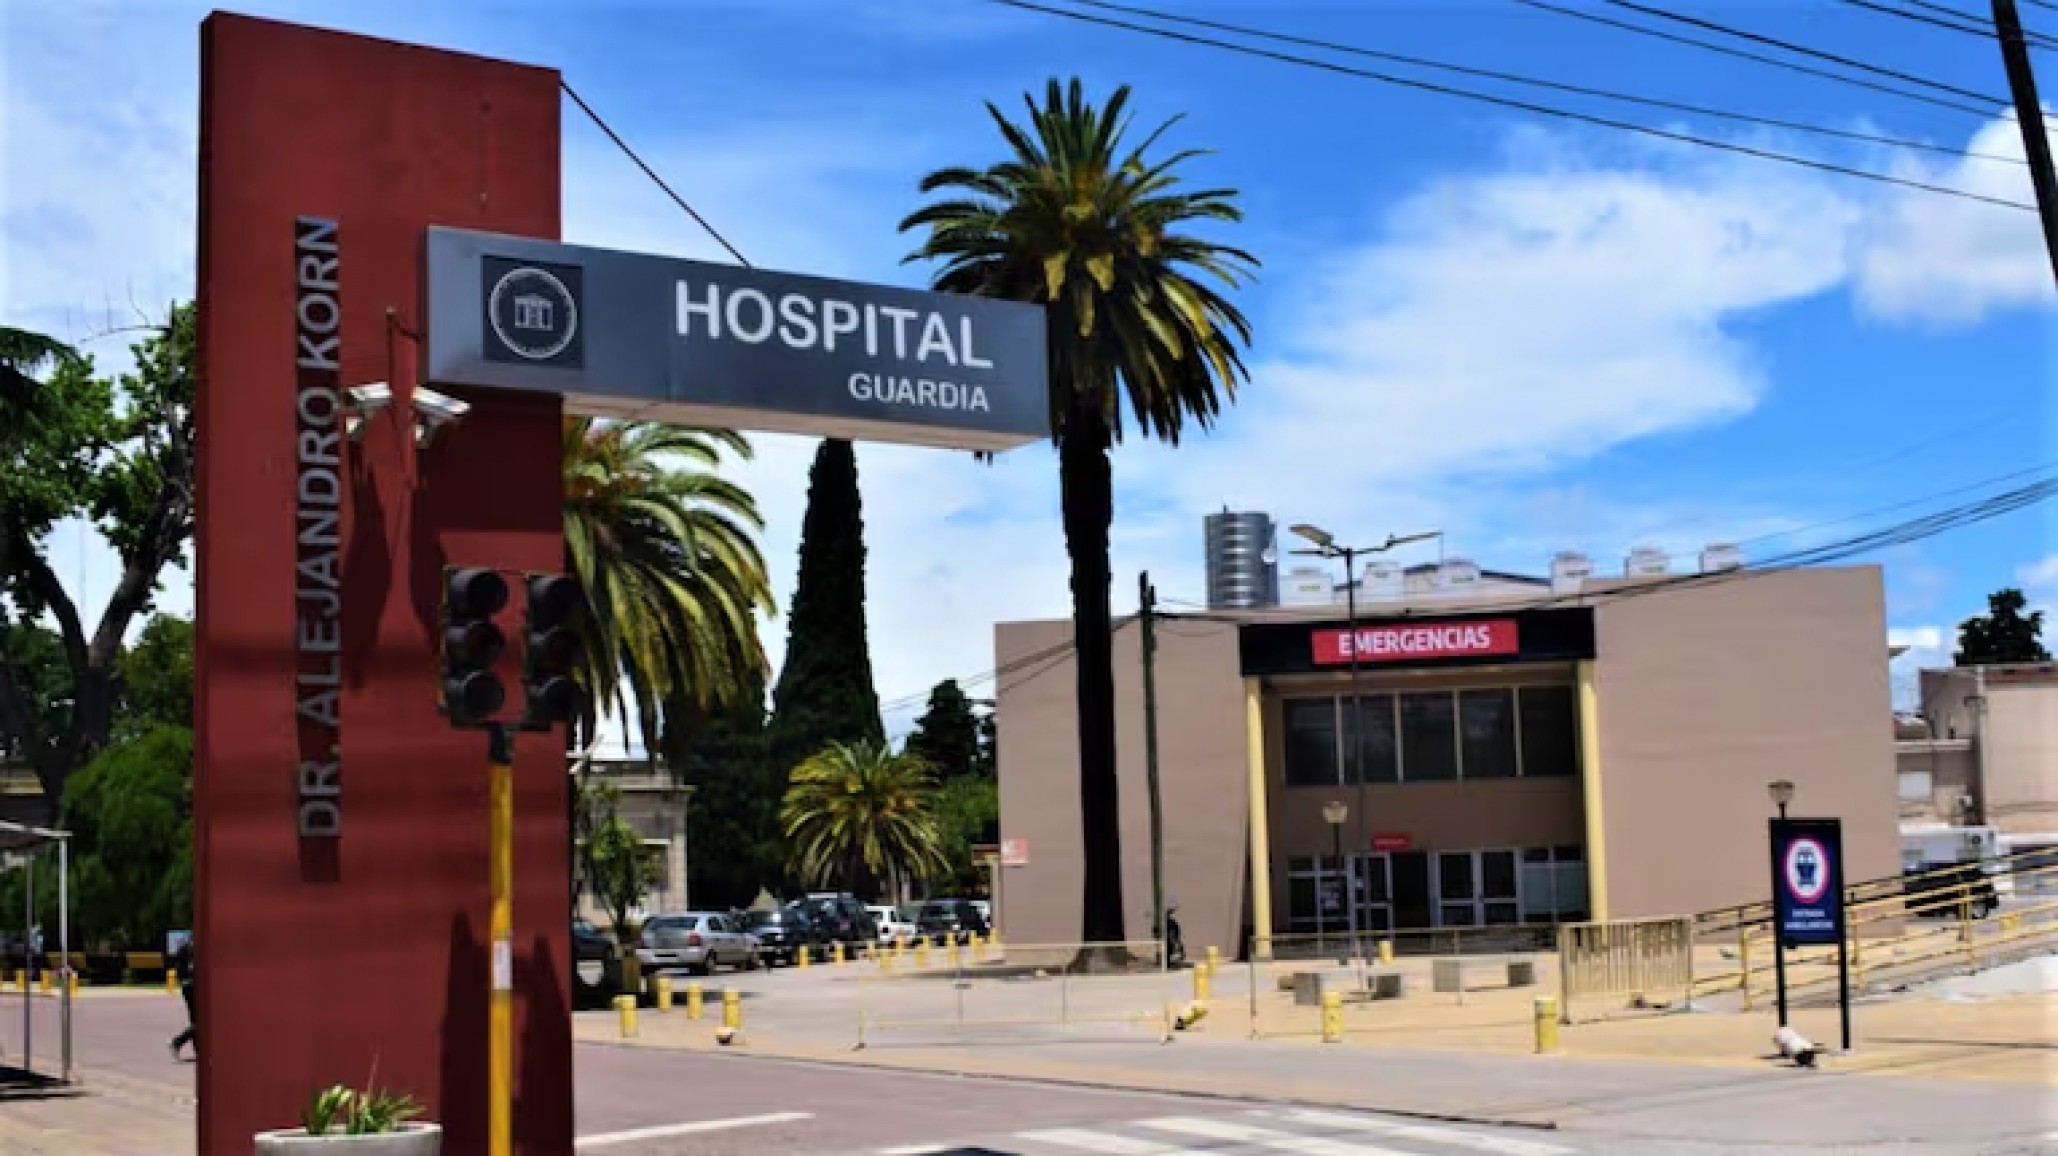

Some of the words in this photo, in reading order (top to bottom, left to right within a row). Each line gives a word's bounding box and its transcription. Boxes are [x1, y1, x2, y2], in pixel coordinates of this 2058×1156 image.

[296, 215, 340, 369] KORN
[675, 279, 994, 369] HOSPITAL
[848, 372, 990, 413] GUARDIA
[298, 387, 341, 727] ALEJANDRO
[1338, 624, 1491, 656] EMERGENCIAS
[299, 743, 341, 837] DR.
